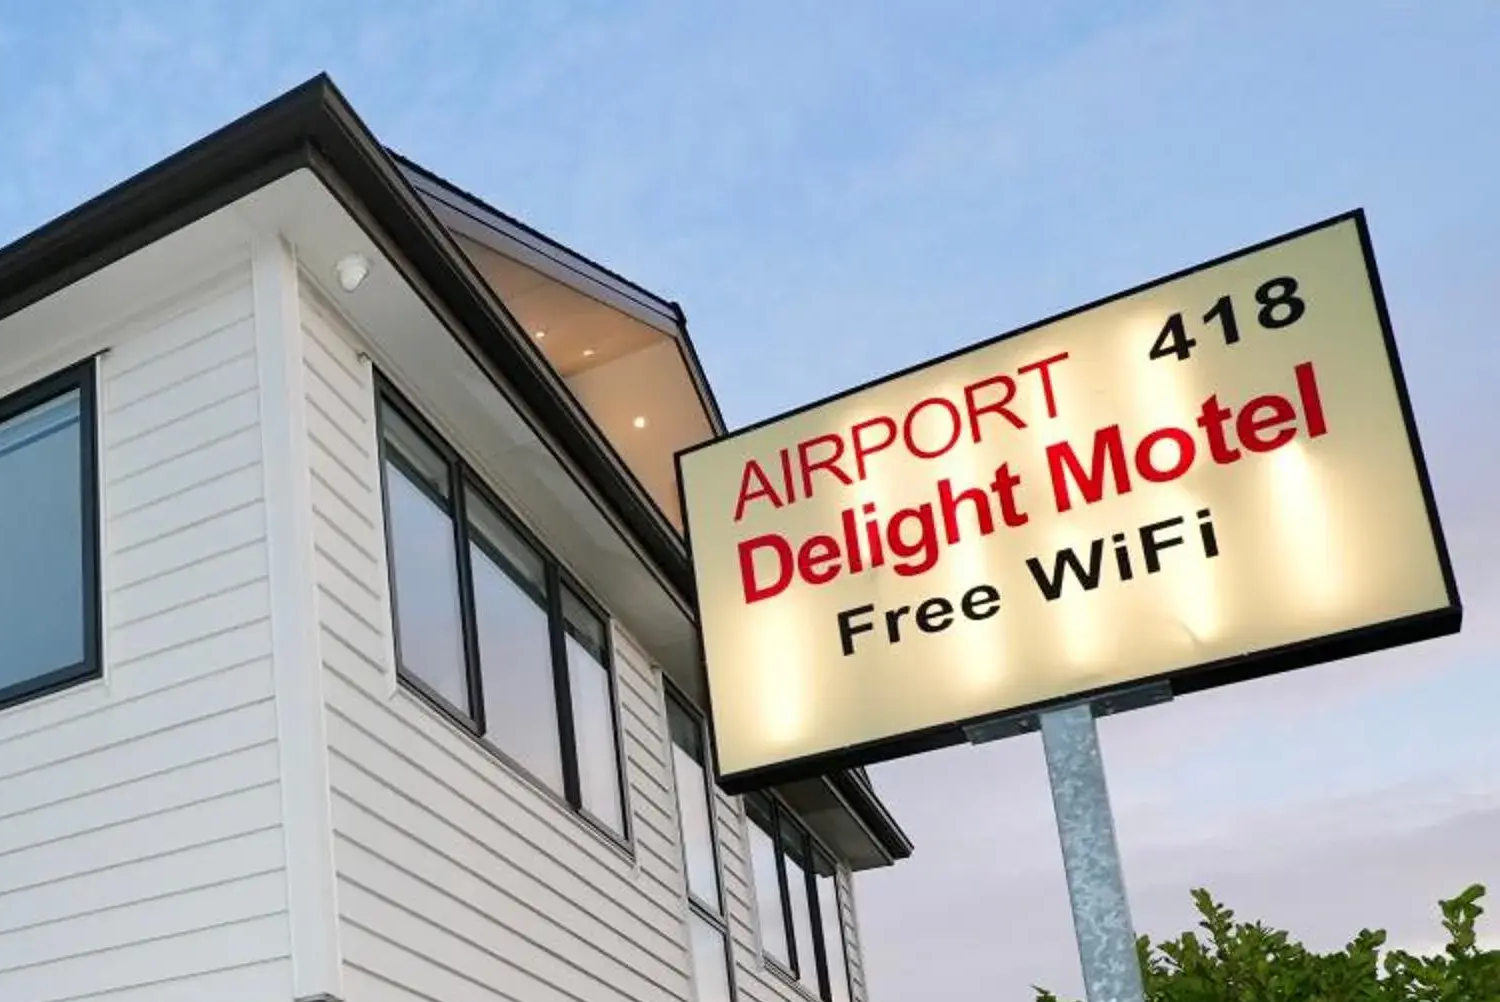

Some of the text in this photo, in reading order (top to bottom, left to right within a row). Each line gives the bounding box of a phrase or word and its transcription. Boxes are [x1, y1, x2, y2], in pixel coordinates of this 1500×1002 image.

[1149, 275, 1307, 362] 418
[734, 352, 1071, 522] AIRPORT
[737, 361, 1329, 605] Delight Motel
[837, 509, 1221, 657] Free WiFi
